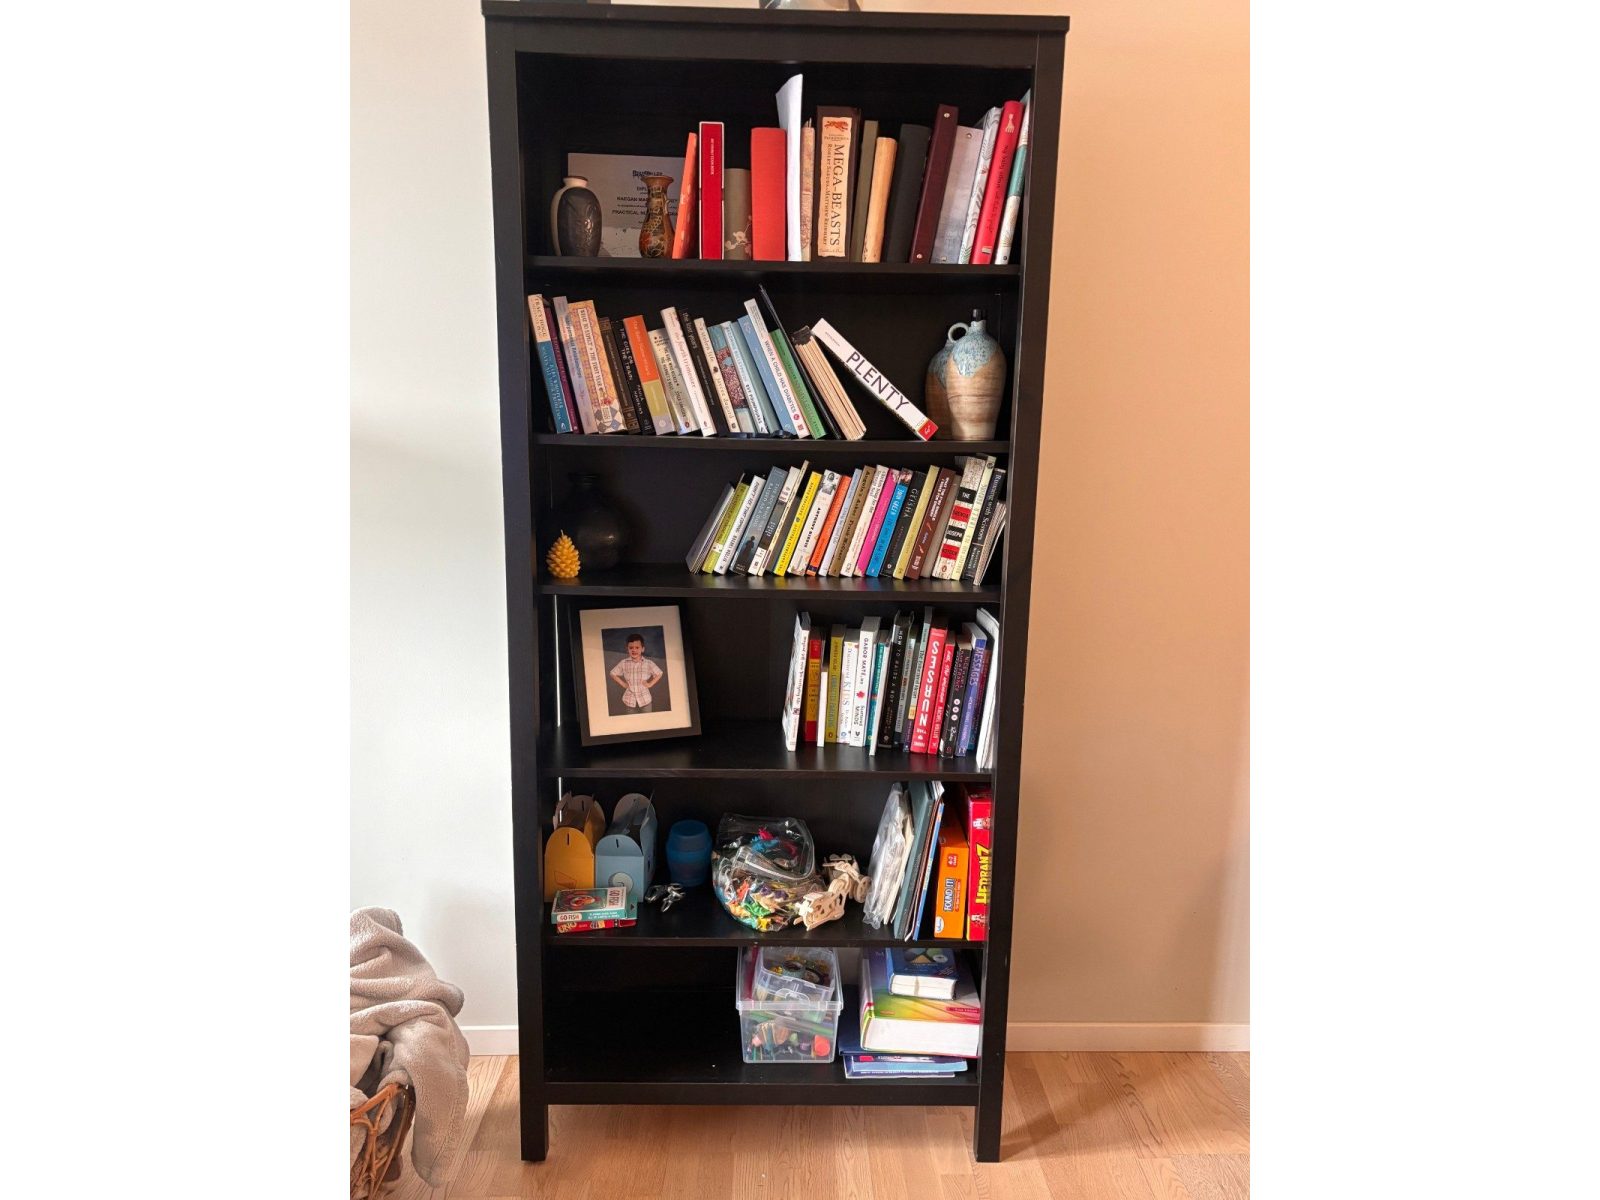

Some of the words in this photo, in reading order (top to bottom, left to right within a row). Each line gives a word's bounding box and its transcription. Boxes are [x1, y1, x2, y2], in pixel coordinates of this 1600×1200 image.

[830, 144, 846, 246] MEGA-BEASTS
[534, 297, 542, 317] TRACY
[682, 311, 690, 322] the
[579, 309, 587, 322] WHAT
[584, 329, 593, 346] EXPECT
[685, 321, 694, 333] lost
[687, 333, 698, 350] years
[701, 331, 711, 350] stolen
[707, 350, 715, 361] life
[763, 340, 774, 356] WHEN
[627, 355, 633, 364] ON
[674, 339, 688, 359] fourth
[682, 358, 696, 389] trimester
[772, 361, 782, 377] CHILD
[778, 376, 787, 388] HAS
[844, 350, 910, 413] PLENTY
[552, 379, 563, 408] WHISPERER
[782, 387, 797, 413] DIABETES
[551, 393, 561, 420] PROBLEMS
[722, 397, 734, 419] dugard
[749, 481, 760, 498] DIDN'T
[762, 481, 774, 502] RAISED
[858, 470, 871, 497] Angela's
[872, 487, 880, 499] Soup
[987, 473, 1002, 501] Running
[767, 494, 775, 504] BOY
[851, 498, 861, 516] Ashes
[889, 499, 900, 516] GREEN
[903, 487, 917, 519] GEISHA
[983, 500, 994, 516] with
[741, 505, 749, 517] THAT
[810, 507, 821, 530] ANTHONY
[844, 519, 854, 536] Frank
[948, 529, 963, 538] JOSEPH
[976, 516, 989, 541] Scissors
[836, 537, 848, 560] McCourt
[895, 648, 900, 656] TO
[968, 646, 983, 686] MESSAGES
[918, 640, 941, 727] NURSES
[954, 668, 962, 691] FRANCE
[842, 681, 850, 705] KIDS
[935, 706, 943, 722] RACHEL
[932, 723, 940, 738] HOLLIS
[608, 897, 620, 907] FISH
[943, 890, 954, 912] FOUND
[558, 922, 576, 933] UNO
